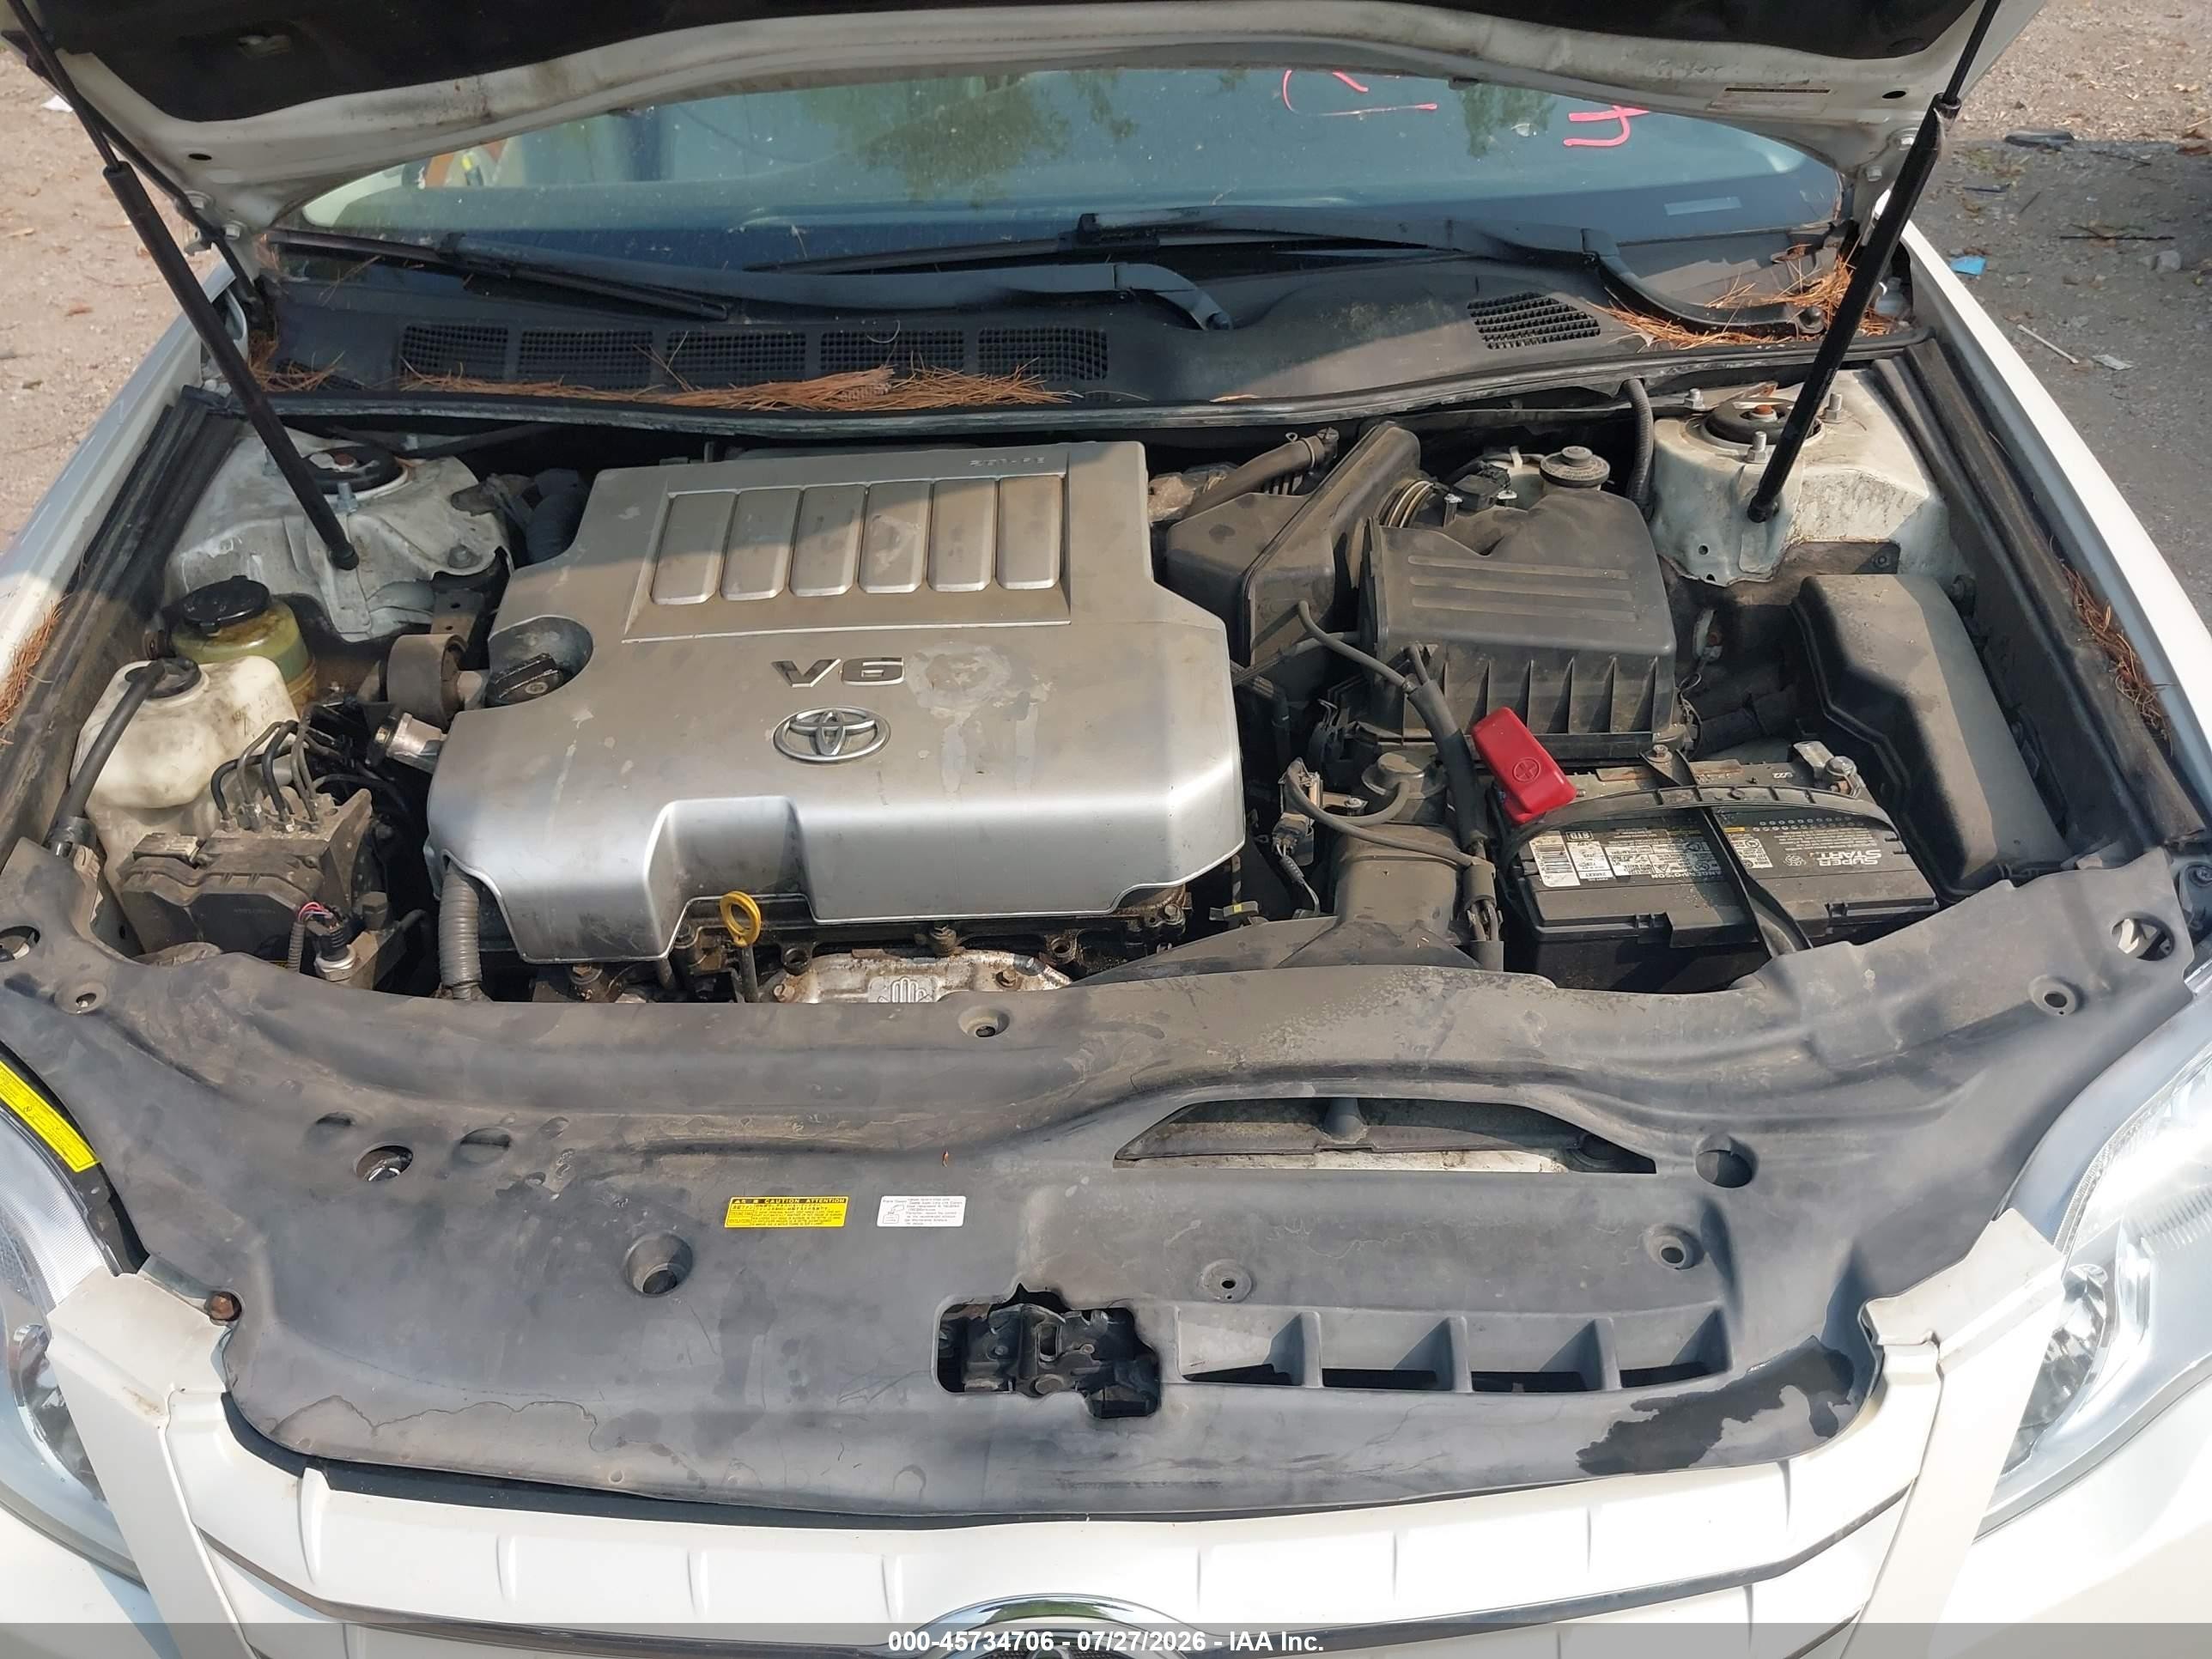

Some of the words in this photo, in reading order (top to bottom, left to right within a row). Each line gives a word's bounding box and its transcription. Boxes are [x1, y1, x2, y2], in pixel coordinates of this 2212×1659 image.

[771, 658, 904, 688] V6
[1814, 849, 1882, 860] START
[1818, 858, 1879, 866] SUPER
